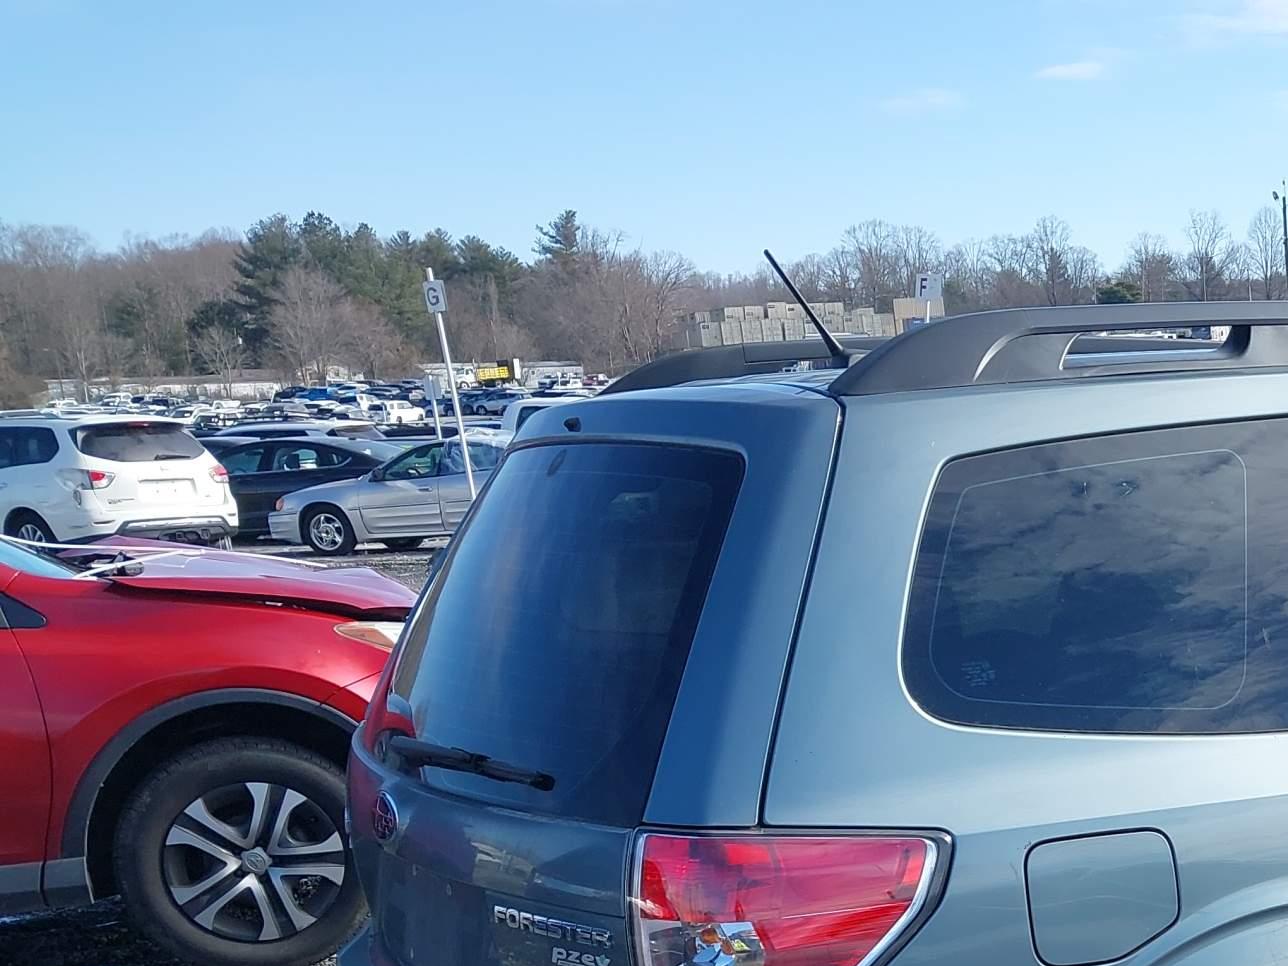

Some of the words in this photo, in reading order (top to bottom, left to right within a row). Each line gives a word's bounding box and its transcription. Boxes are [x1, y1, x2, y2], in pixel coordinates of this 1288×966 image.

[426, 287, 440, 306] G
[919, 277, 928, 297] F
[494, 905, 612, 948] FORESTER
